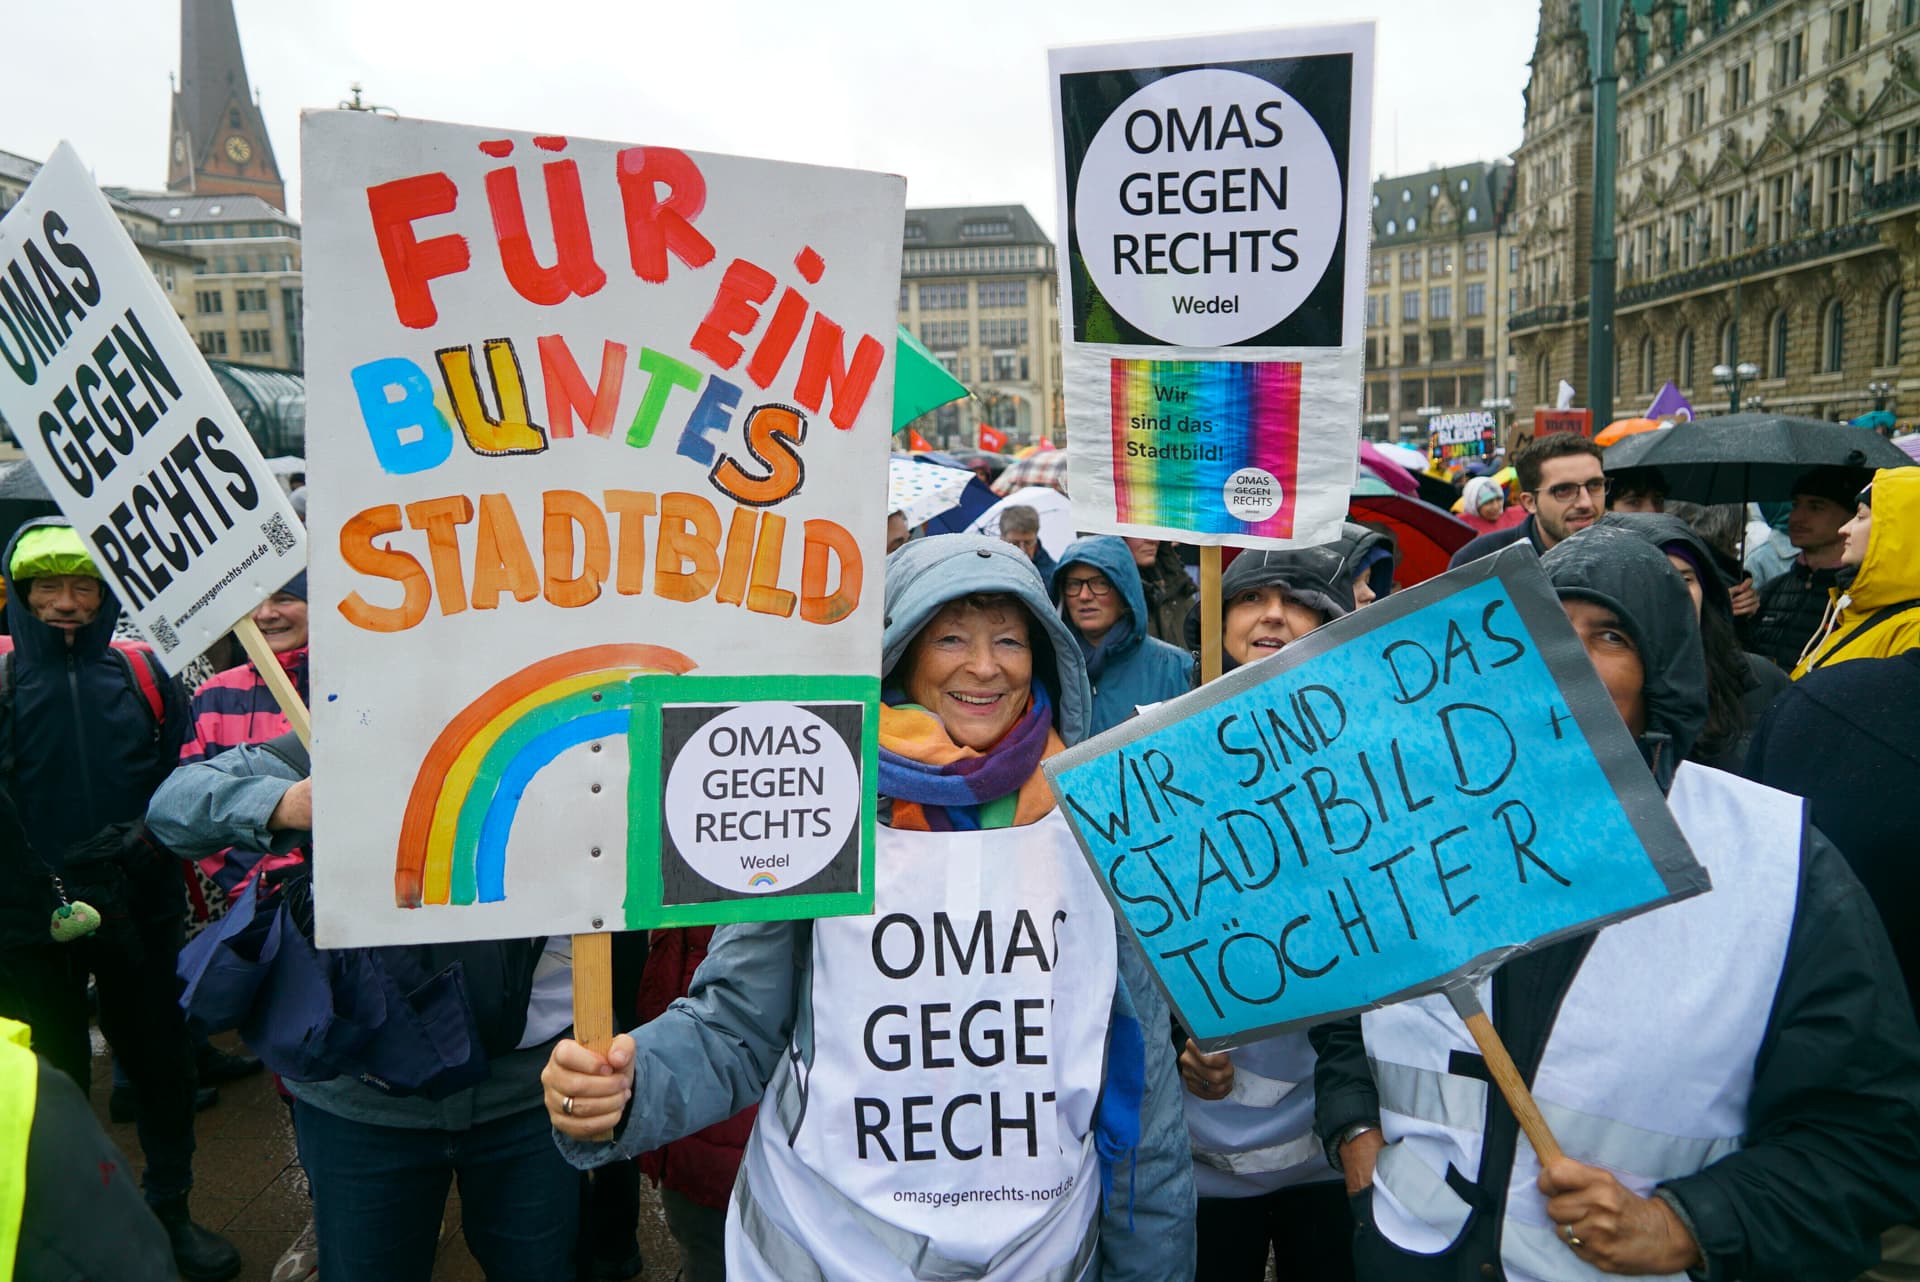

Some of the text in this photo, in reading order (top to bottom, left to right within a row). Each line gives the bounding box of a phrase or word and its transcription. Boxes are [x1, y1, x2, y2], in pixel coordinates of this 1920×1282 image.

[1125, 101, 1283, 154] OMAS
[1120, 166, 1288, 215] GEGEN
[367, 136, 716, 329] FÜR
[1114, 228, 1299, 275] RECHTS
[1172, 295, 1239, 314] Wedel
[690, 245, 885, 431] EIN
[38, 308, 183, 499] GEGEN
[1154, 386, 1188, 403] Wir
[351, 337, 808, 507] BUNTES
[1131, 414, 1213, 433] sind das
[1439, 426, 1484, 446] BLEIBT
[1126, 441, 1224, 461] Stadtbild!
[1233, 496, 1273, 507] RECHTS
[1235, 487, 1271, 496] GEGEN
[1236, 476, 1270, 486] OMAS
[91, 416, 259, 612] RECHTS
[337, 489, 864, 632] STADTBILD
[174, 543, 269, 628] www.omasgegenrechts-nord.de
[708, 725, 822, 757] OMAS
[1065, 600, 1526, 846] WIR SIND DAS
[702, 766, 824, 800] GEGEN
[695, 808, 832, 843] RECHTS
[1109, 702, 1518, 938] STADTBILD
[740, 854, 790, 870] Wedel
[1160, 799, 1572, 1019] TÖCHTER
[863, 998, 1055, 1071] GEGE
[893, 1175, 1074, 1208] omasgegenrechts-nord.de
